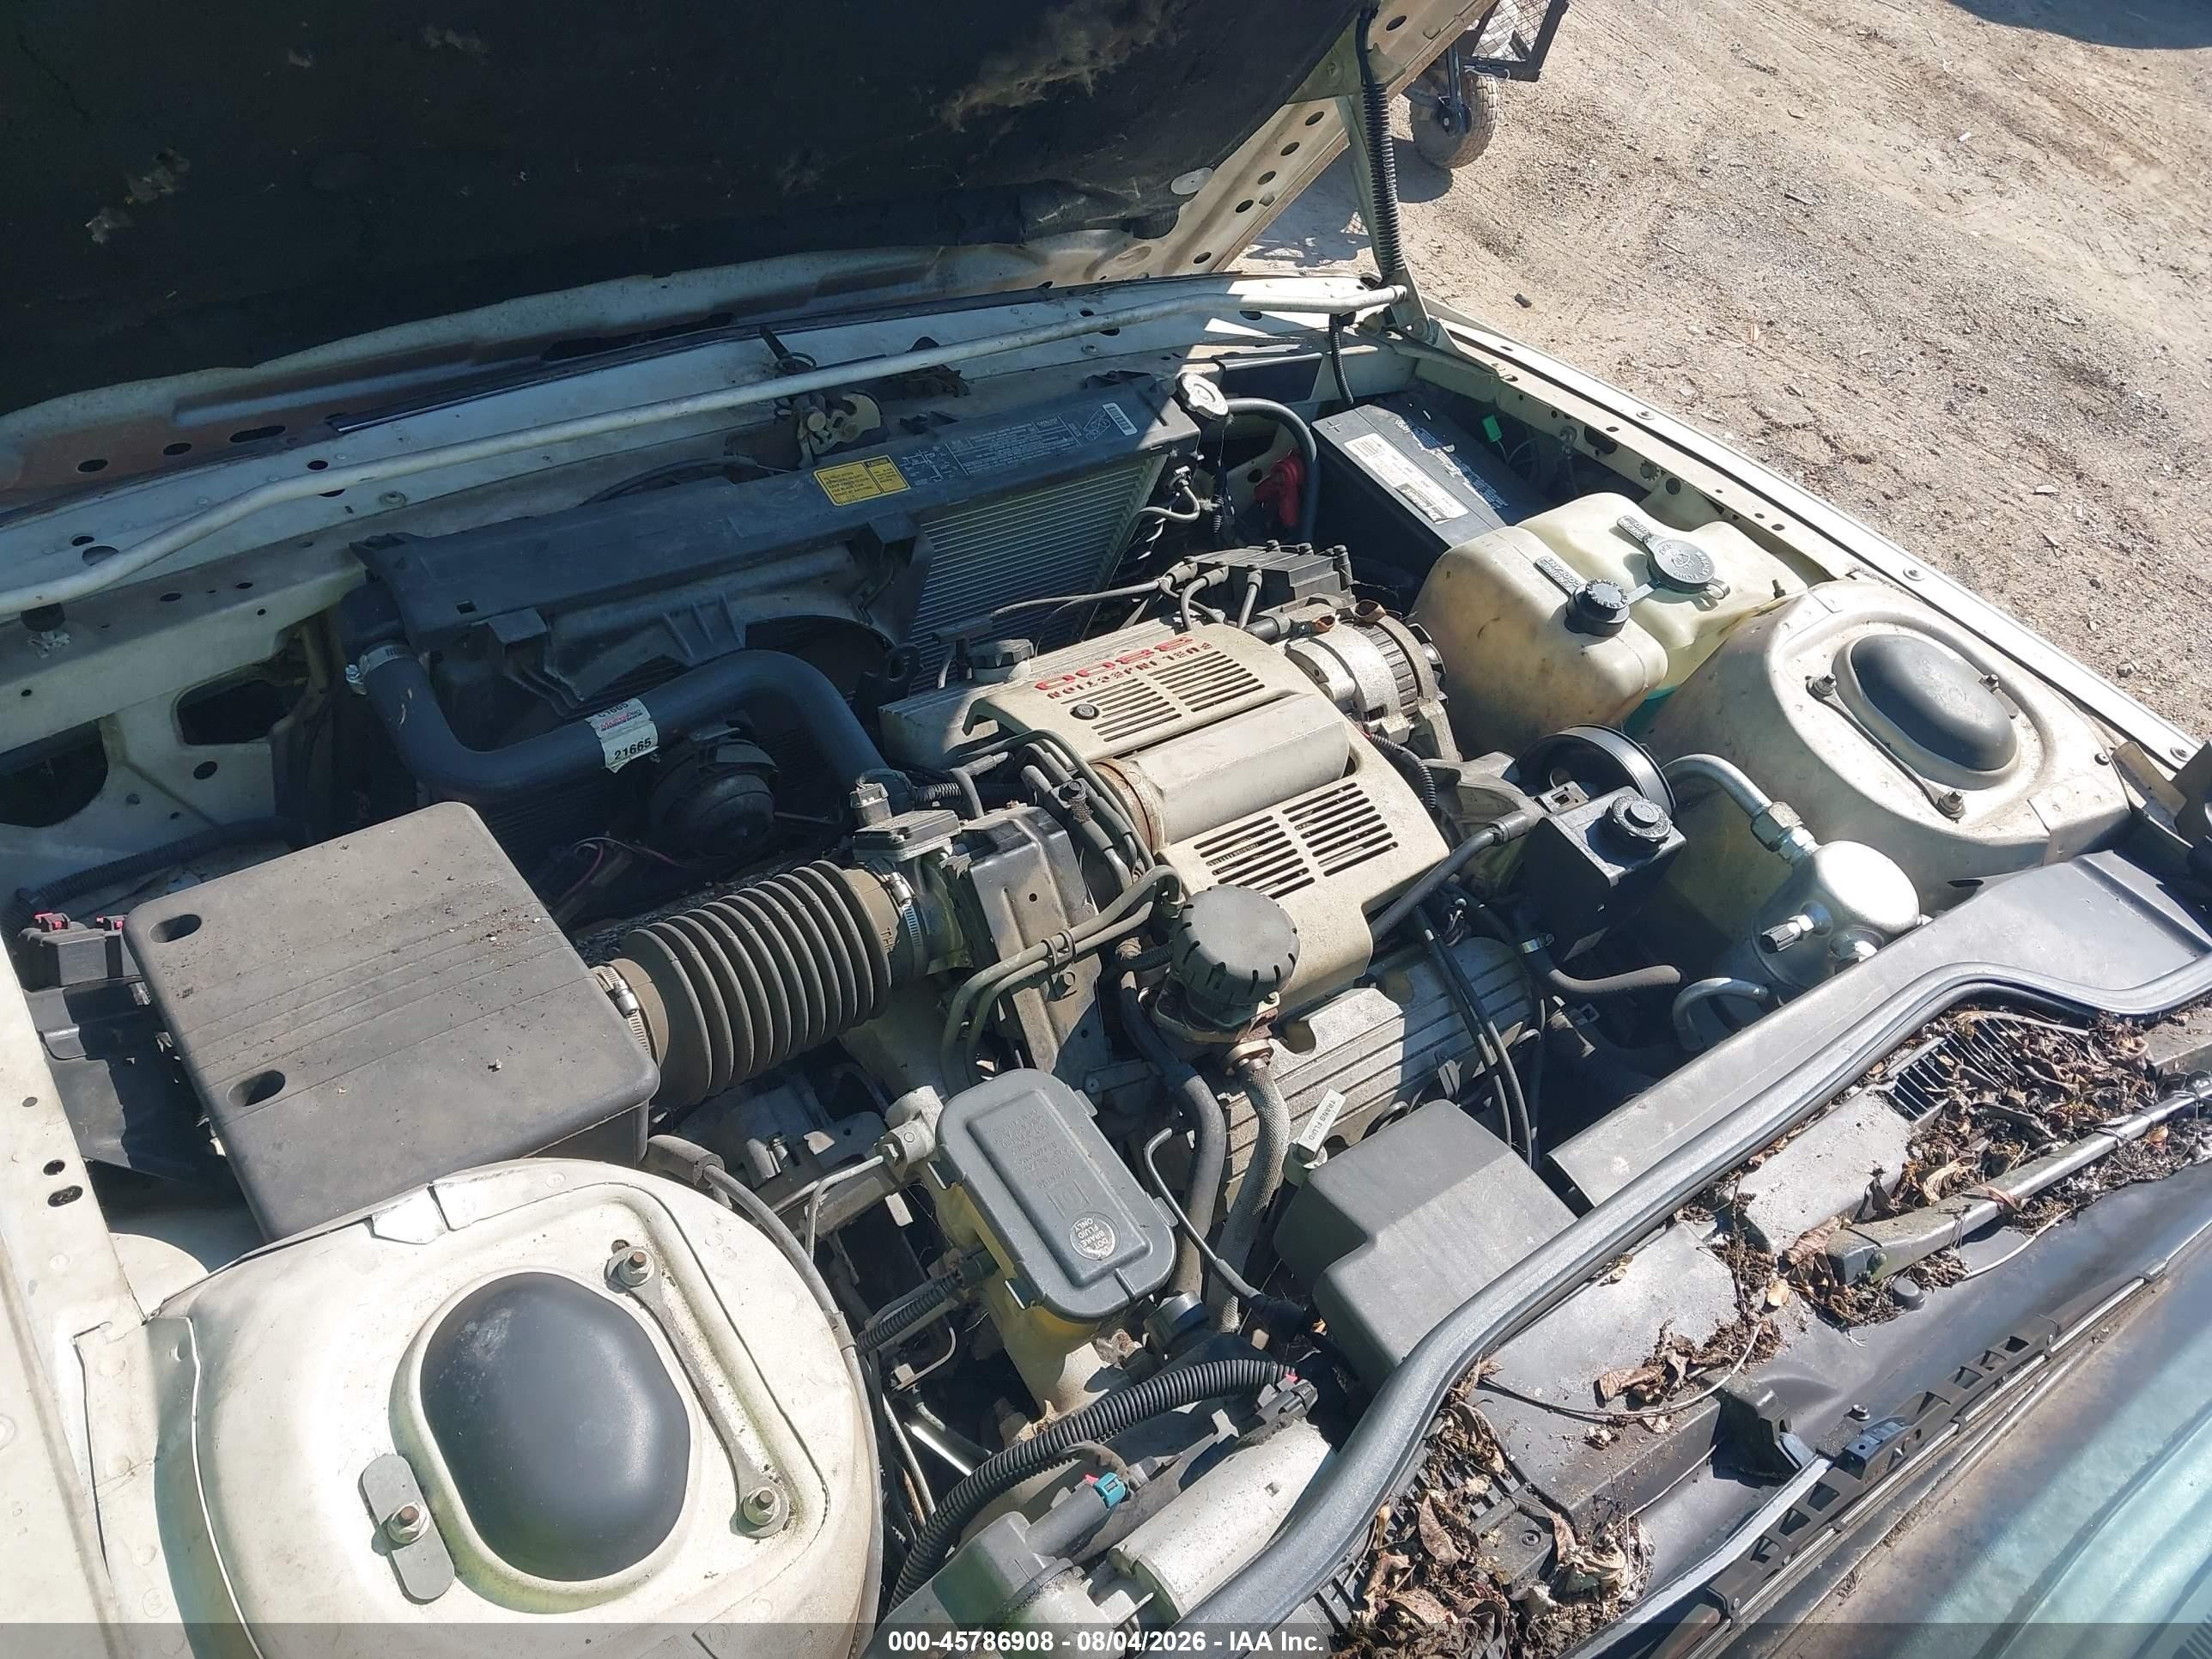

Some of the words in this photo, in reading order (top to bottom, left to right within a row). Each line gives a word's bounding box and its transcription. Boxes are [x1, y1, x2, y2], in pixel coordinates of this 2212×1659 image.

[1046, 659, 1159, 700] INJECTION
[615, 738, 652, 759] 21665
[1308, 1121, 1323, 1141] FLUID
[1074, 1218, 1093, 1233] ONLY
[1078, 1224, 1099, 1239] FLUID
[1079, 1230, 1105, 1248] BRAKE
